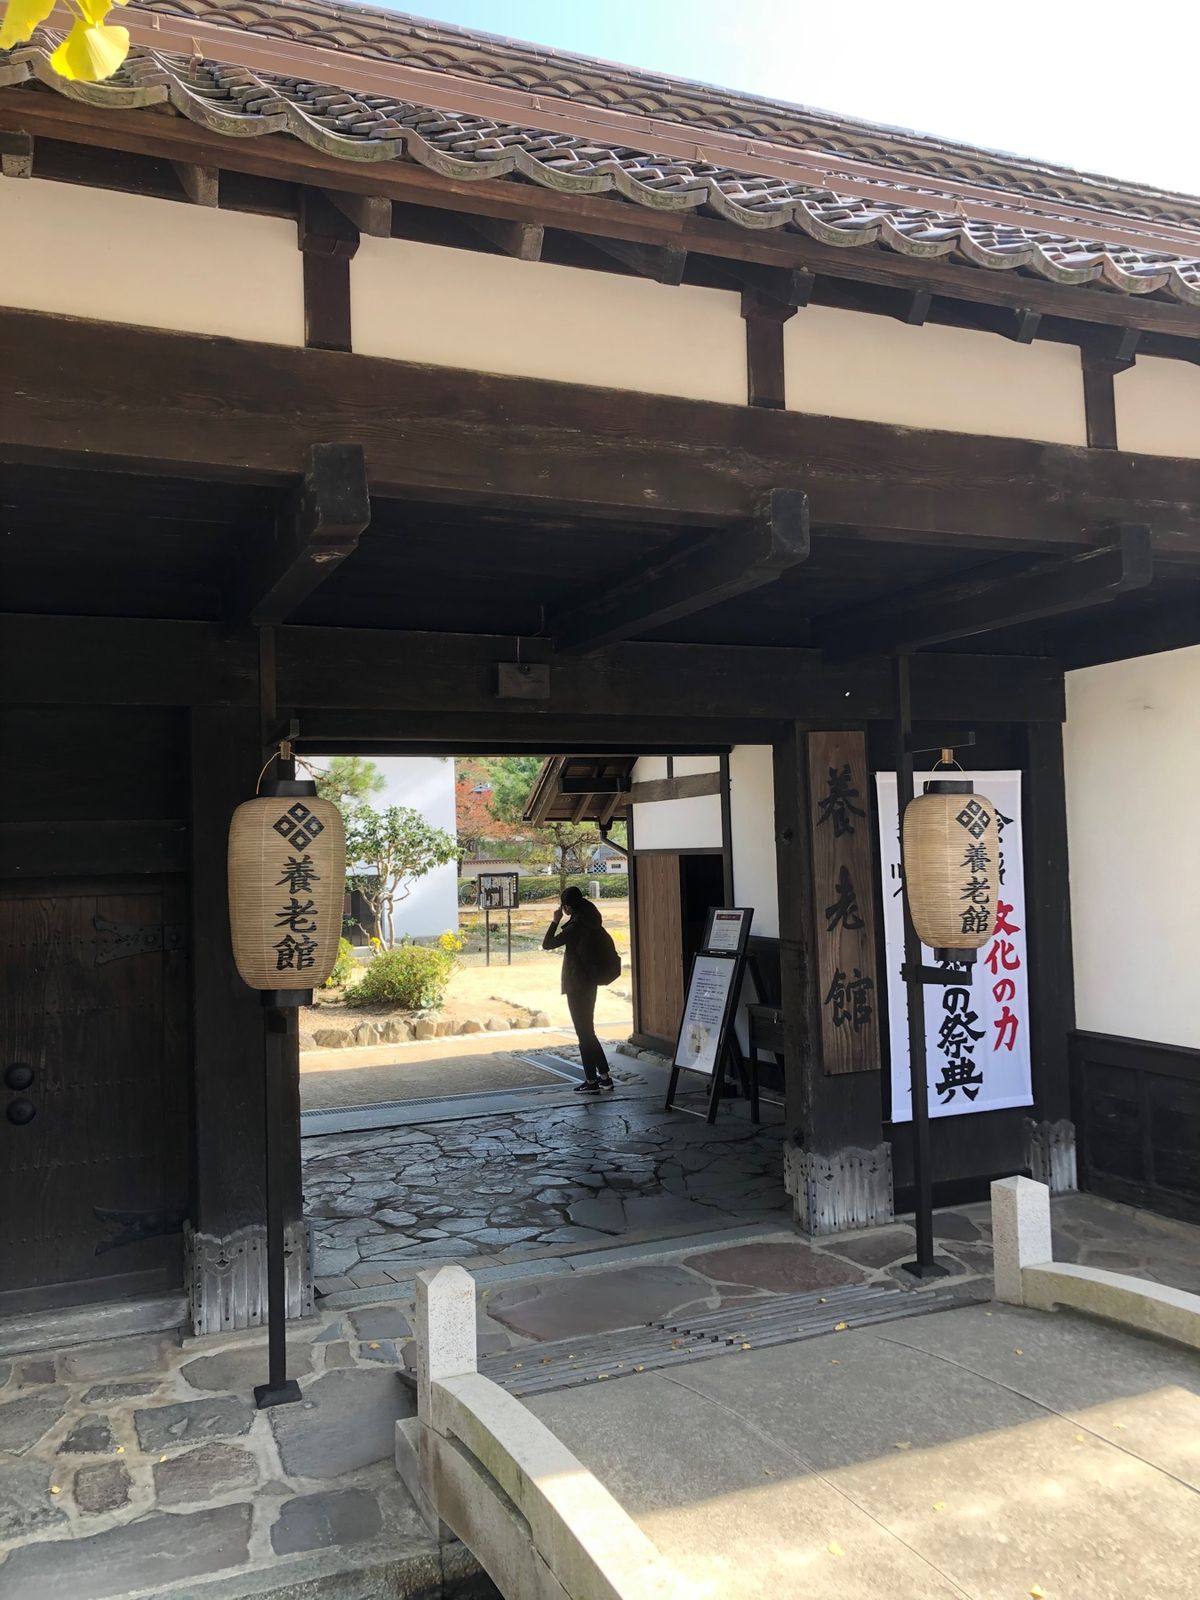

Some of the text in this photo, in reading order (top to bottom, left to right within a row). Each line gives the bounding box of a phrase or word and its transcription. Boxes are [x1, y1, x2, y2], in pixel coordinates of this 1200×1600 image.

[272, 854, 321, 971] 養老館
[816, 763, 874, 1033] 養老館
[959, 843, 992, 934] 養老館
